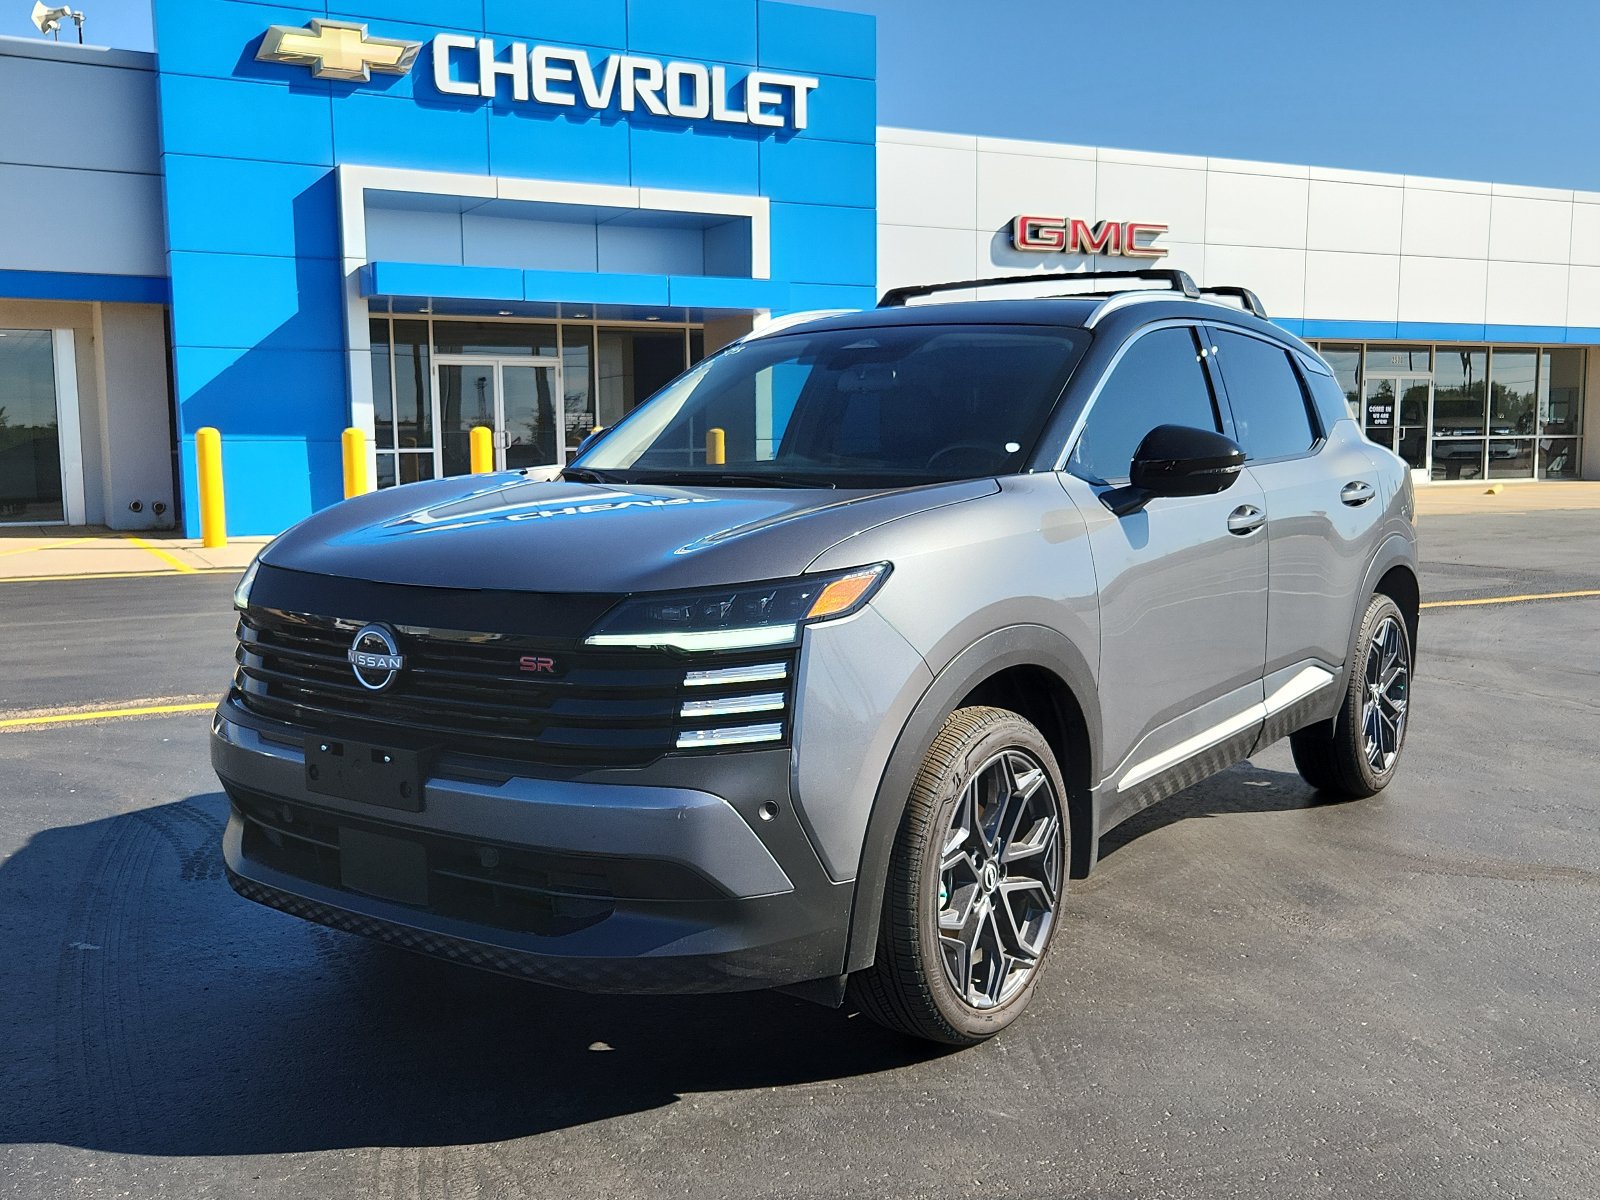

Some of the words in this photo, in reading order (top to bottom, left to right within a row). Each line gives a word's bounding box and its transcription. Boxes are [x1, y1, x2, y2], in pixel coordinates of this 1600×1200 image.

[433, 33, 819, 129] CHEVROLET
[1013, 215, 1169, 258] GMC
[348, 650, 400, 668] NISSAN
[519, 656, 554, 672] SR
